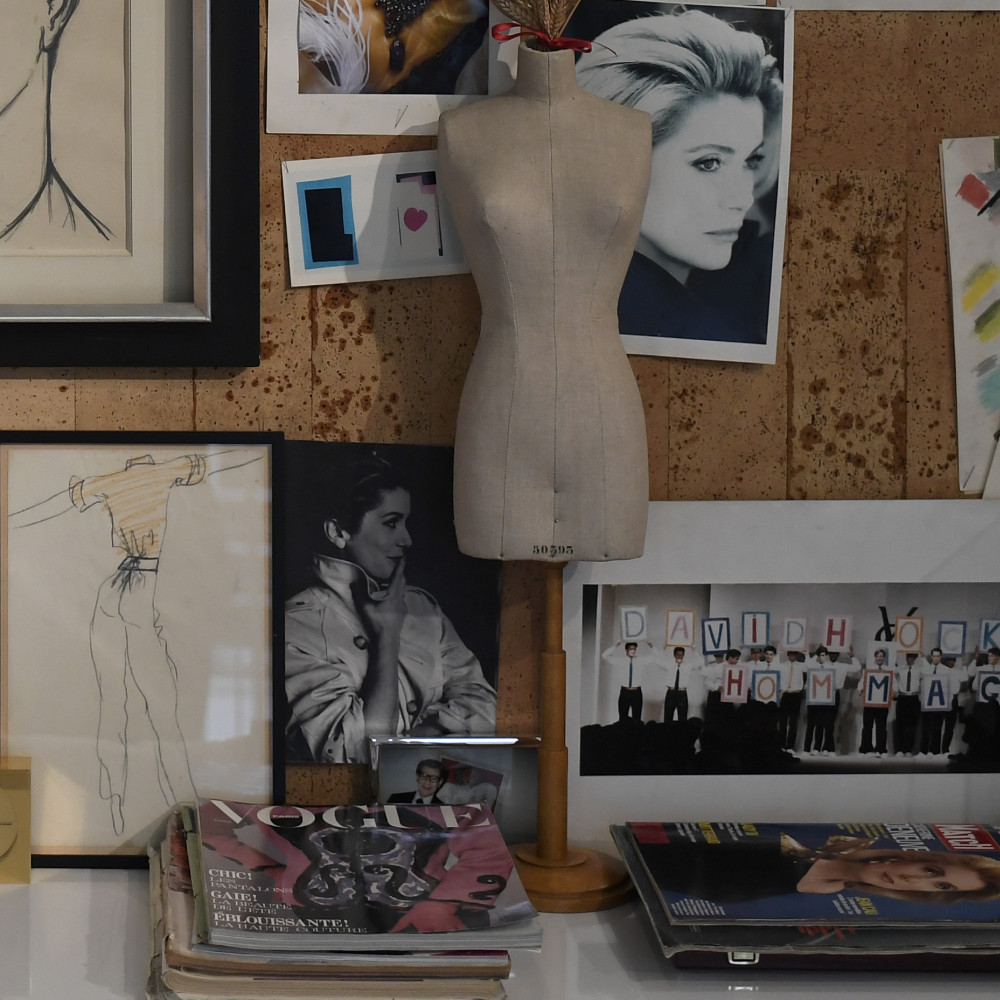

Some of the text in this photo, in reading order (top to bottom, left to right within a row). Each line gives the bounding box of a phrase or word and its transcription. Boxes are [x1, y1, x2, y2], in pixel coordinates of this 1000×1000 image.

[210, 799, 491, 829] VOGUE
[934, 823, 996, 850] MATCH
[208, 868, 253, 880] CHIC!
[210, 890, 258, 902] GAIE!
[238, 922, 290, 932] HAUTE
[296, 926, 368, 934] COUTURE
